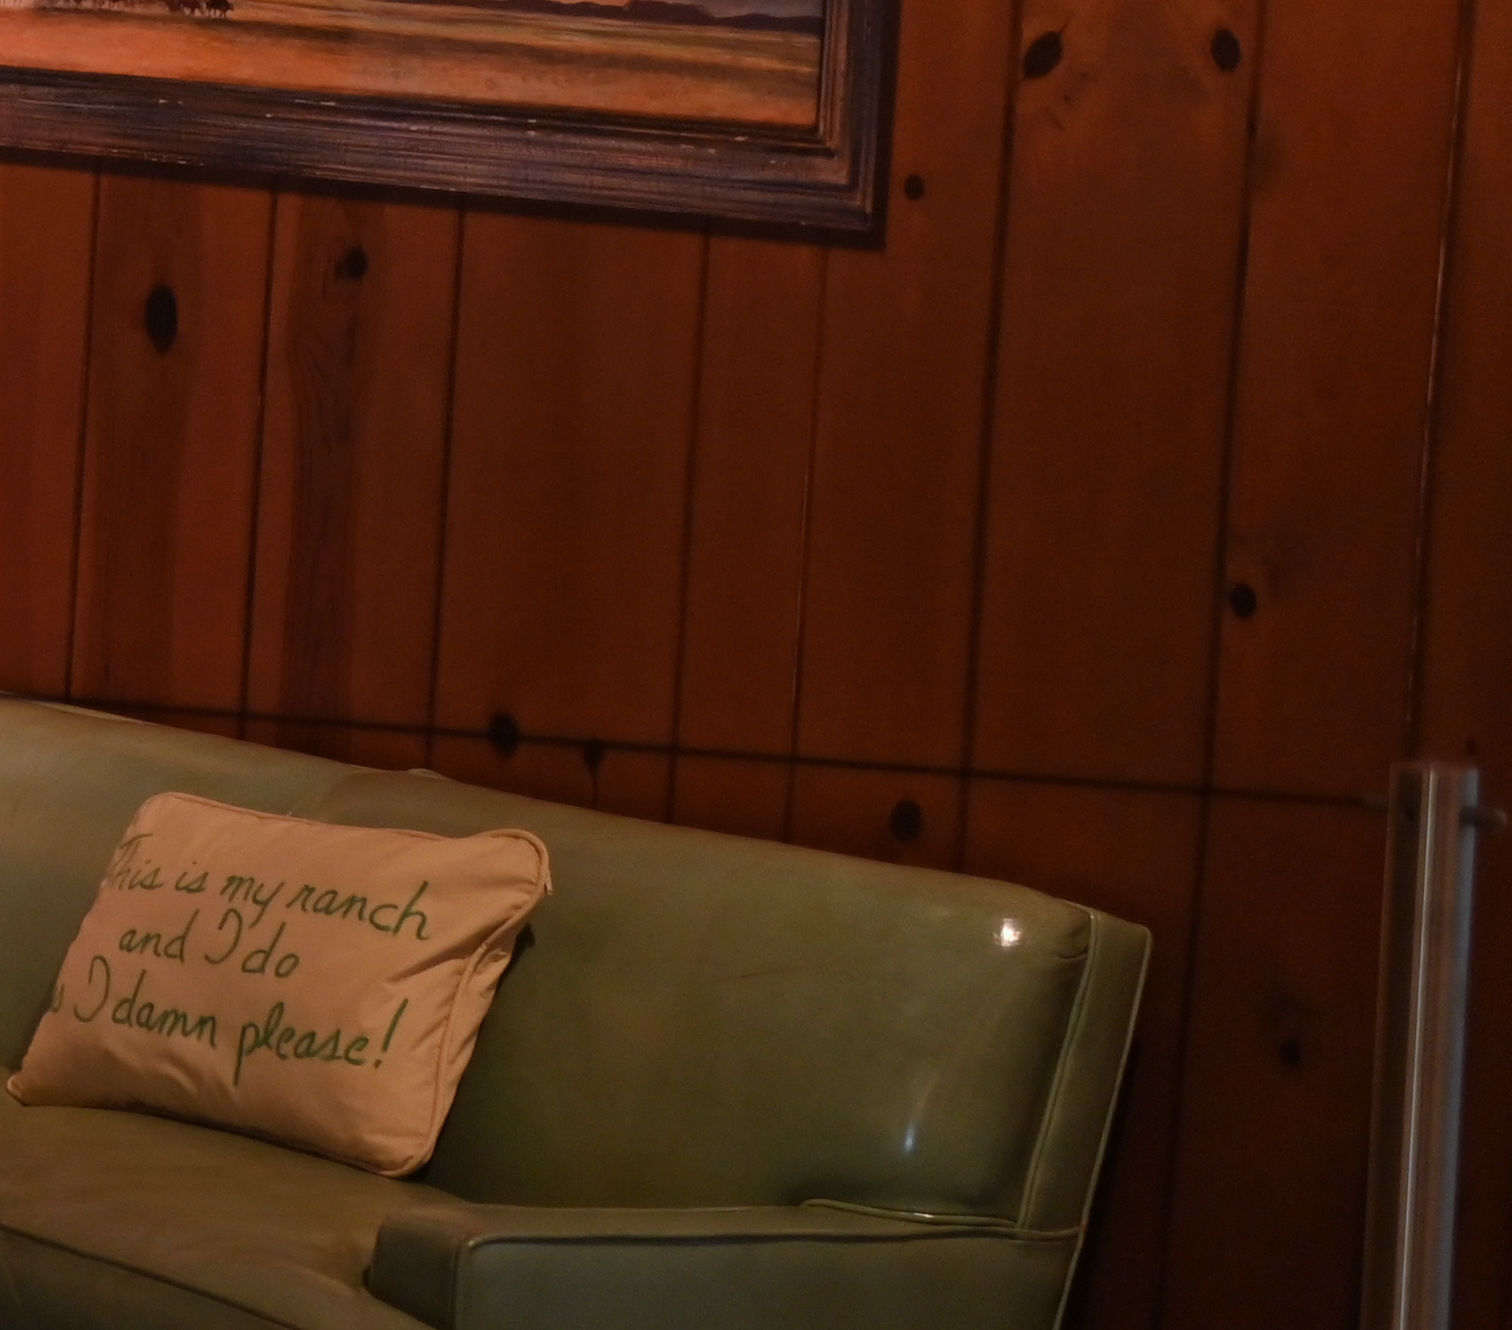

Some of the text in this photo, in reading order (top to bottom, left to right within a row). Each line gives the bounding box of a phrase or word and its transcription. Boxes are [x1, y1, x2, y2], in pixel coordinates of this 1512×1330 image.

[175, 861, 209, 894] is
[220, 874, 285, 930] my
[285, 880, 431, 940] ranch
[118, 908, 200, 964] and
[241, 921, 300, 978] do
[112, 969, 217, 1049] damn
[232, 998, 409, 1086] please!
